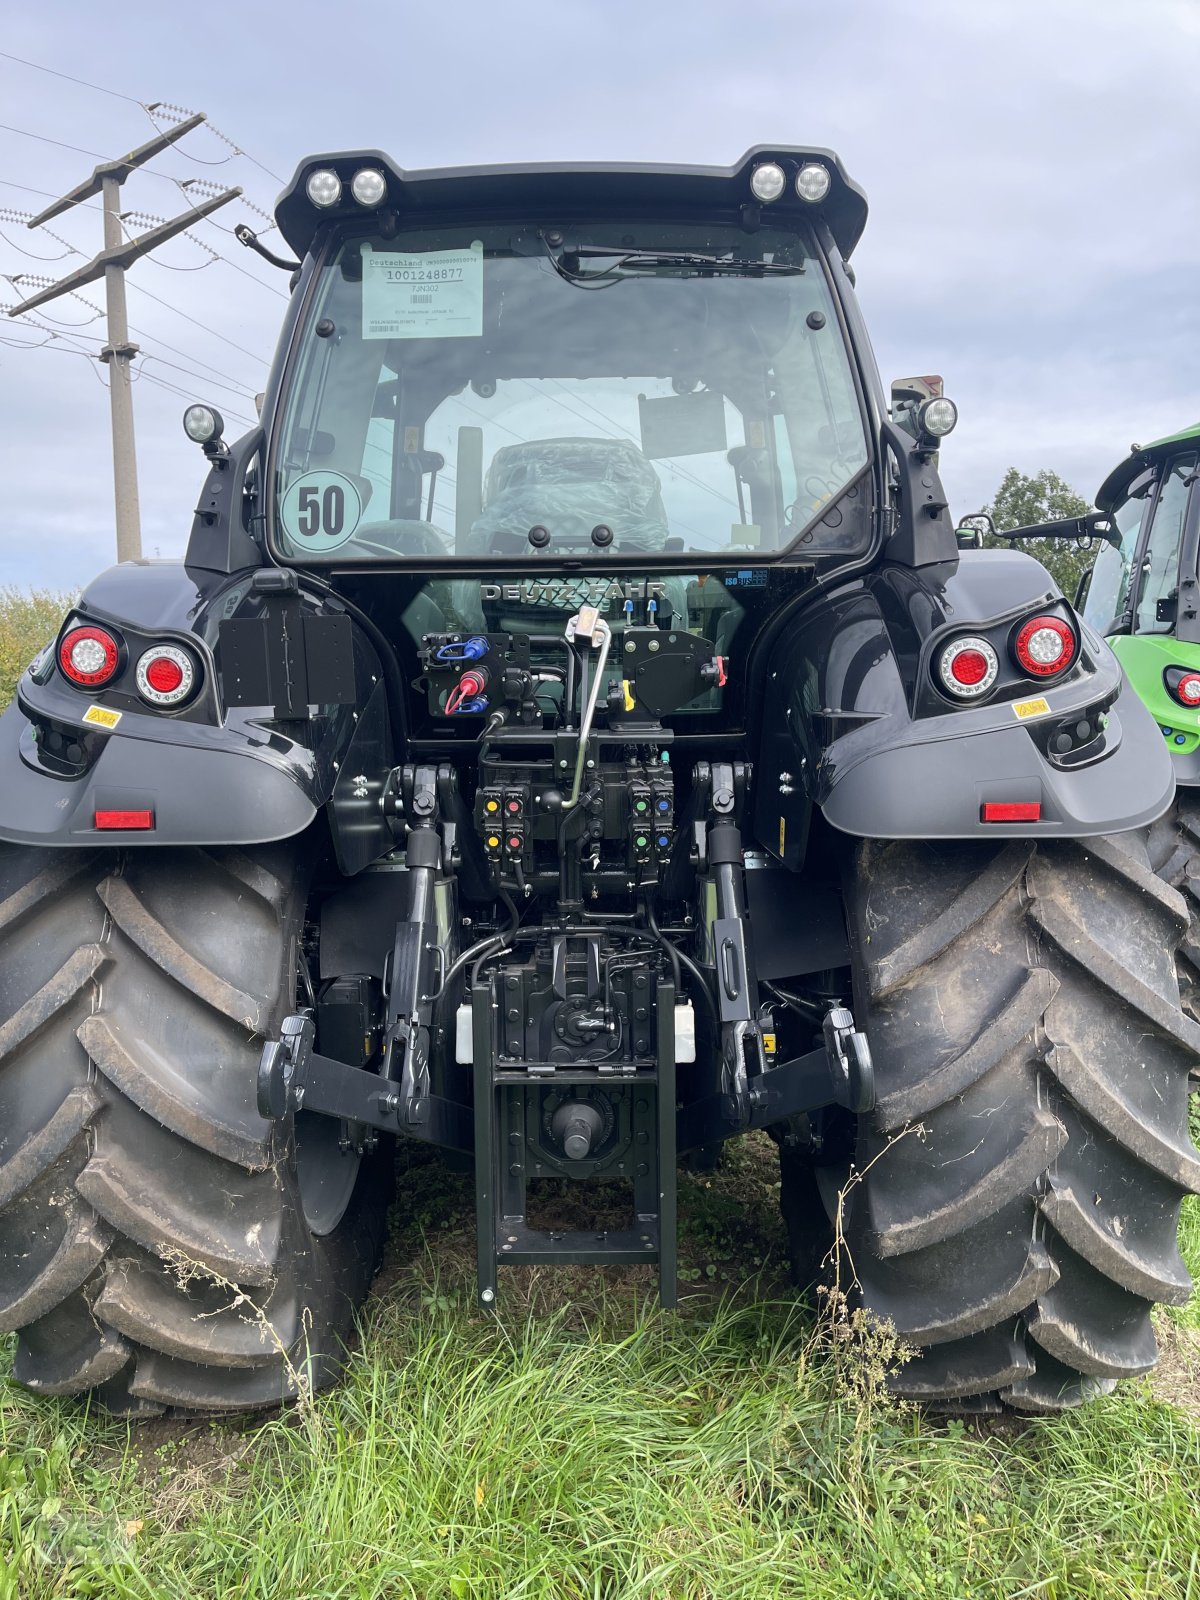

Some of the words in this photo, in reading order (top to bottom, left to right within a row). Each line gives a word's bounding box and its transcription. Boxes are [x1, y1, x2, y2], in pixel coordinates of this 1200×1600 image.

[387, 268, 463, 280] 1001248877
[298, 485, 345, 537] 50
[480, 582, 667, 600] DEUTZ-FAHR
